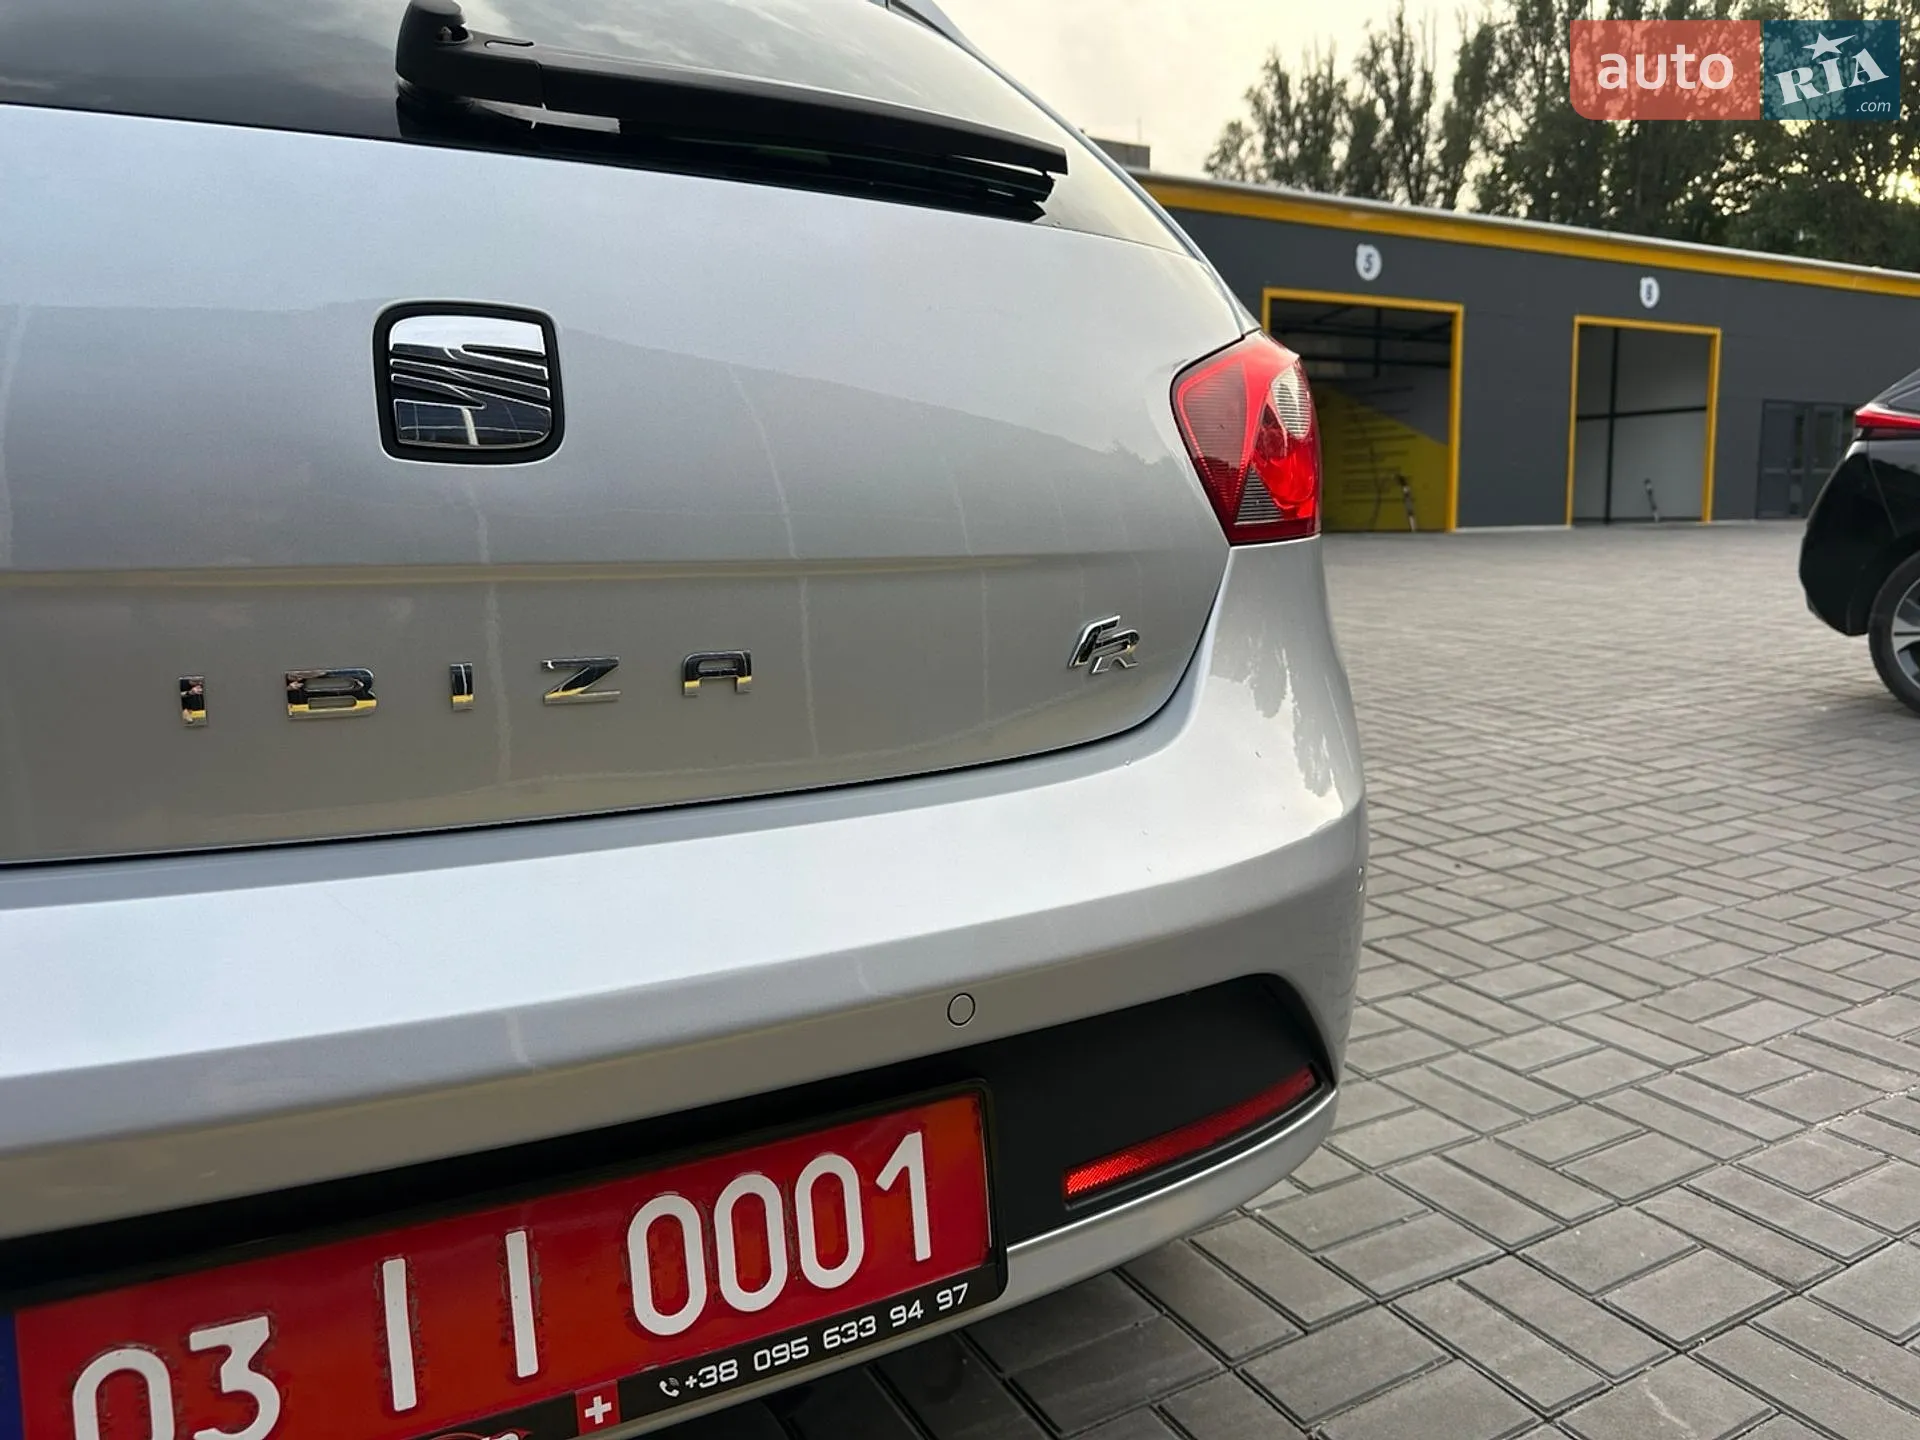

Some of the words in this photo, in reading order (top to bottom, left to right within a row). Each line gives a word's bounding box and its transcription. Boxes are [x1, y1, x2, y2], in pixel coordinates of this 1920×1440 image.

[178, 648, 753, 728] IBIZA
[1067, 614, 1140, 675] FR
[72, 1315, 281, 1440] 03
[626, 1131, 932, 1336] 0001
[684, 1358, 740, 1390] +38
[752, 1336, 810, 1372] 095
[822, 1314, 877, 1350] 633
[889, 1299, 925, 1328] 94
[935, 1282, 970, 1311] 97
